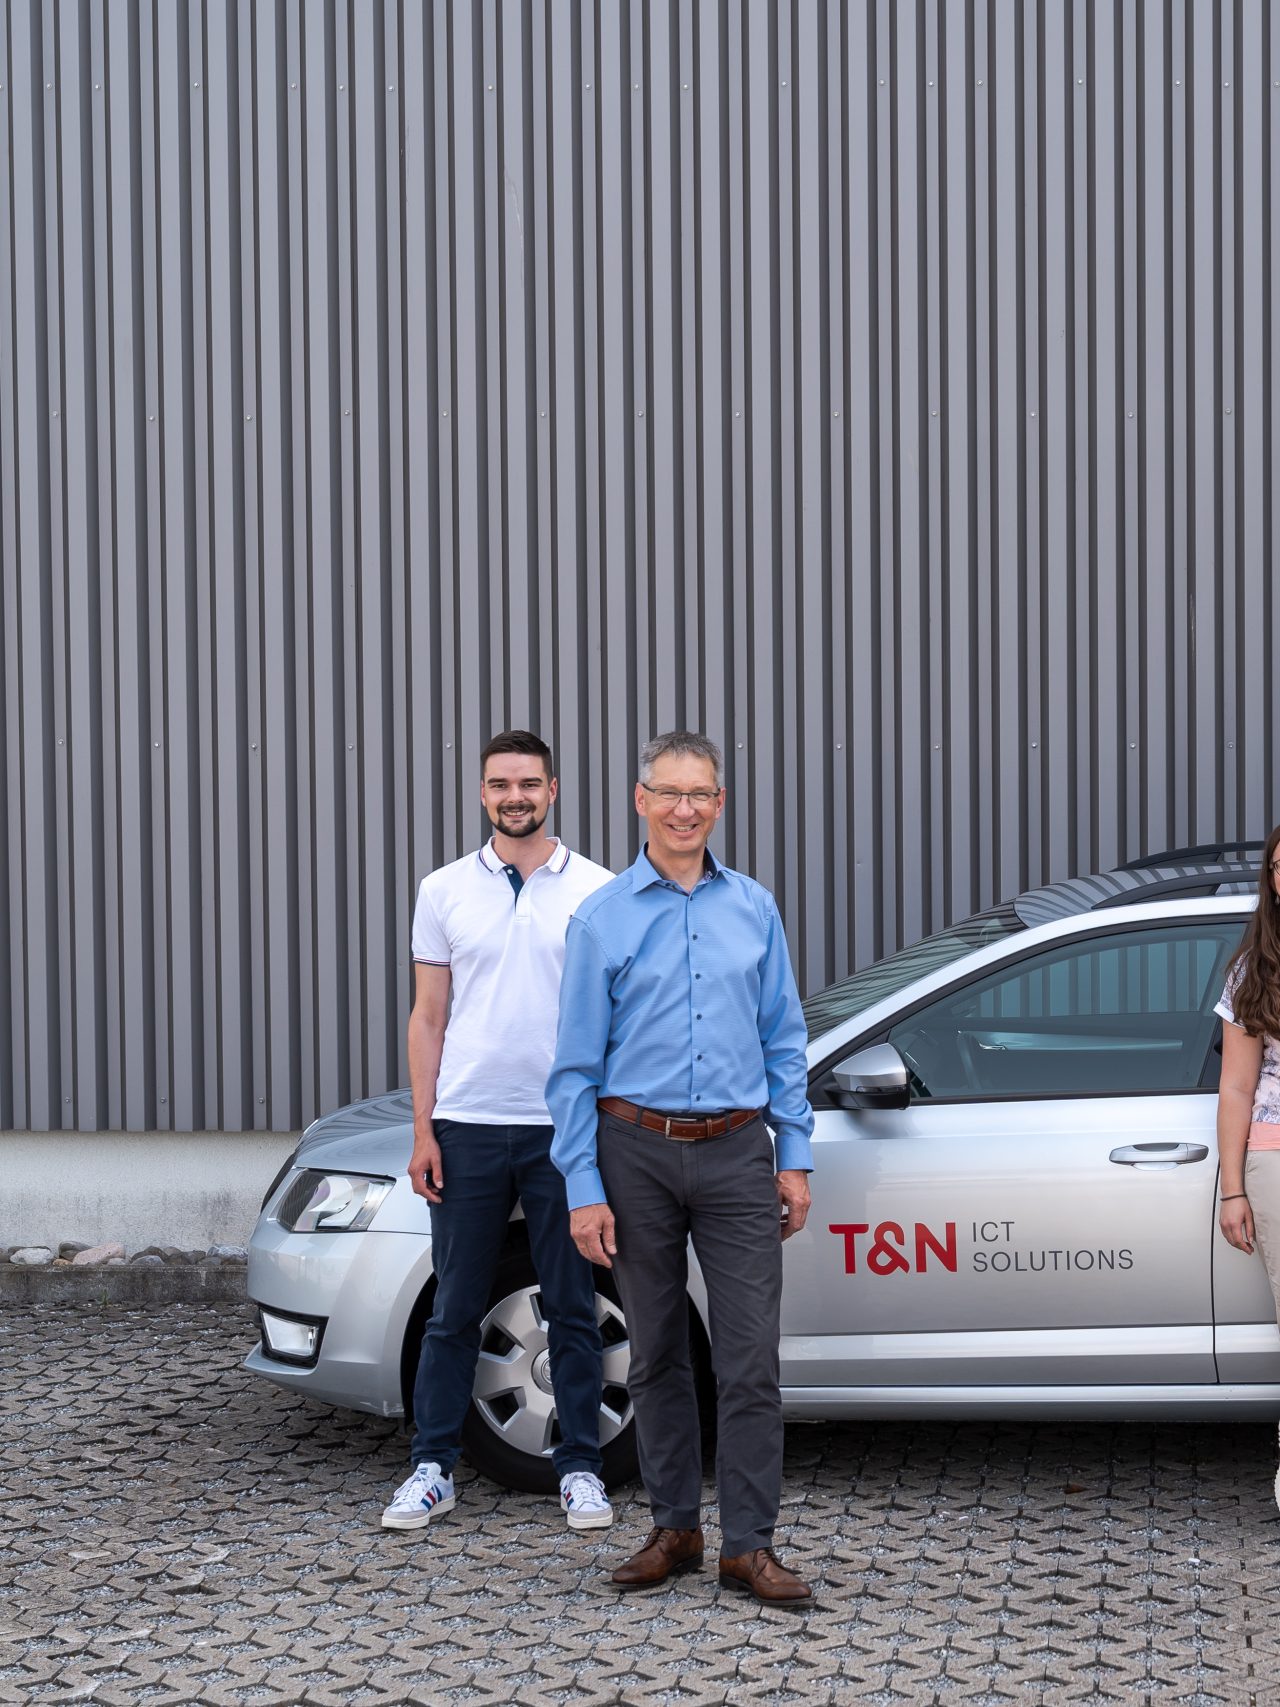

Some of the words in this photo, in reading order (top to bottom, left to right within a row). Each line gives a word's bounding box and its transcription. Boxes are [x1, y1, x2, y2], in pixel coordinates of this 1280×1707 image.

[972, 1221, 1015, 1242] ICT
[828, 1221, 958, 1276] T&N
[972, 1249, 1135, 1272] SOLUTIONS
